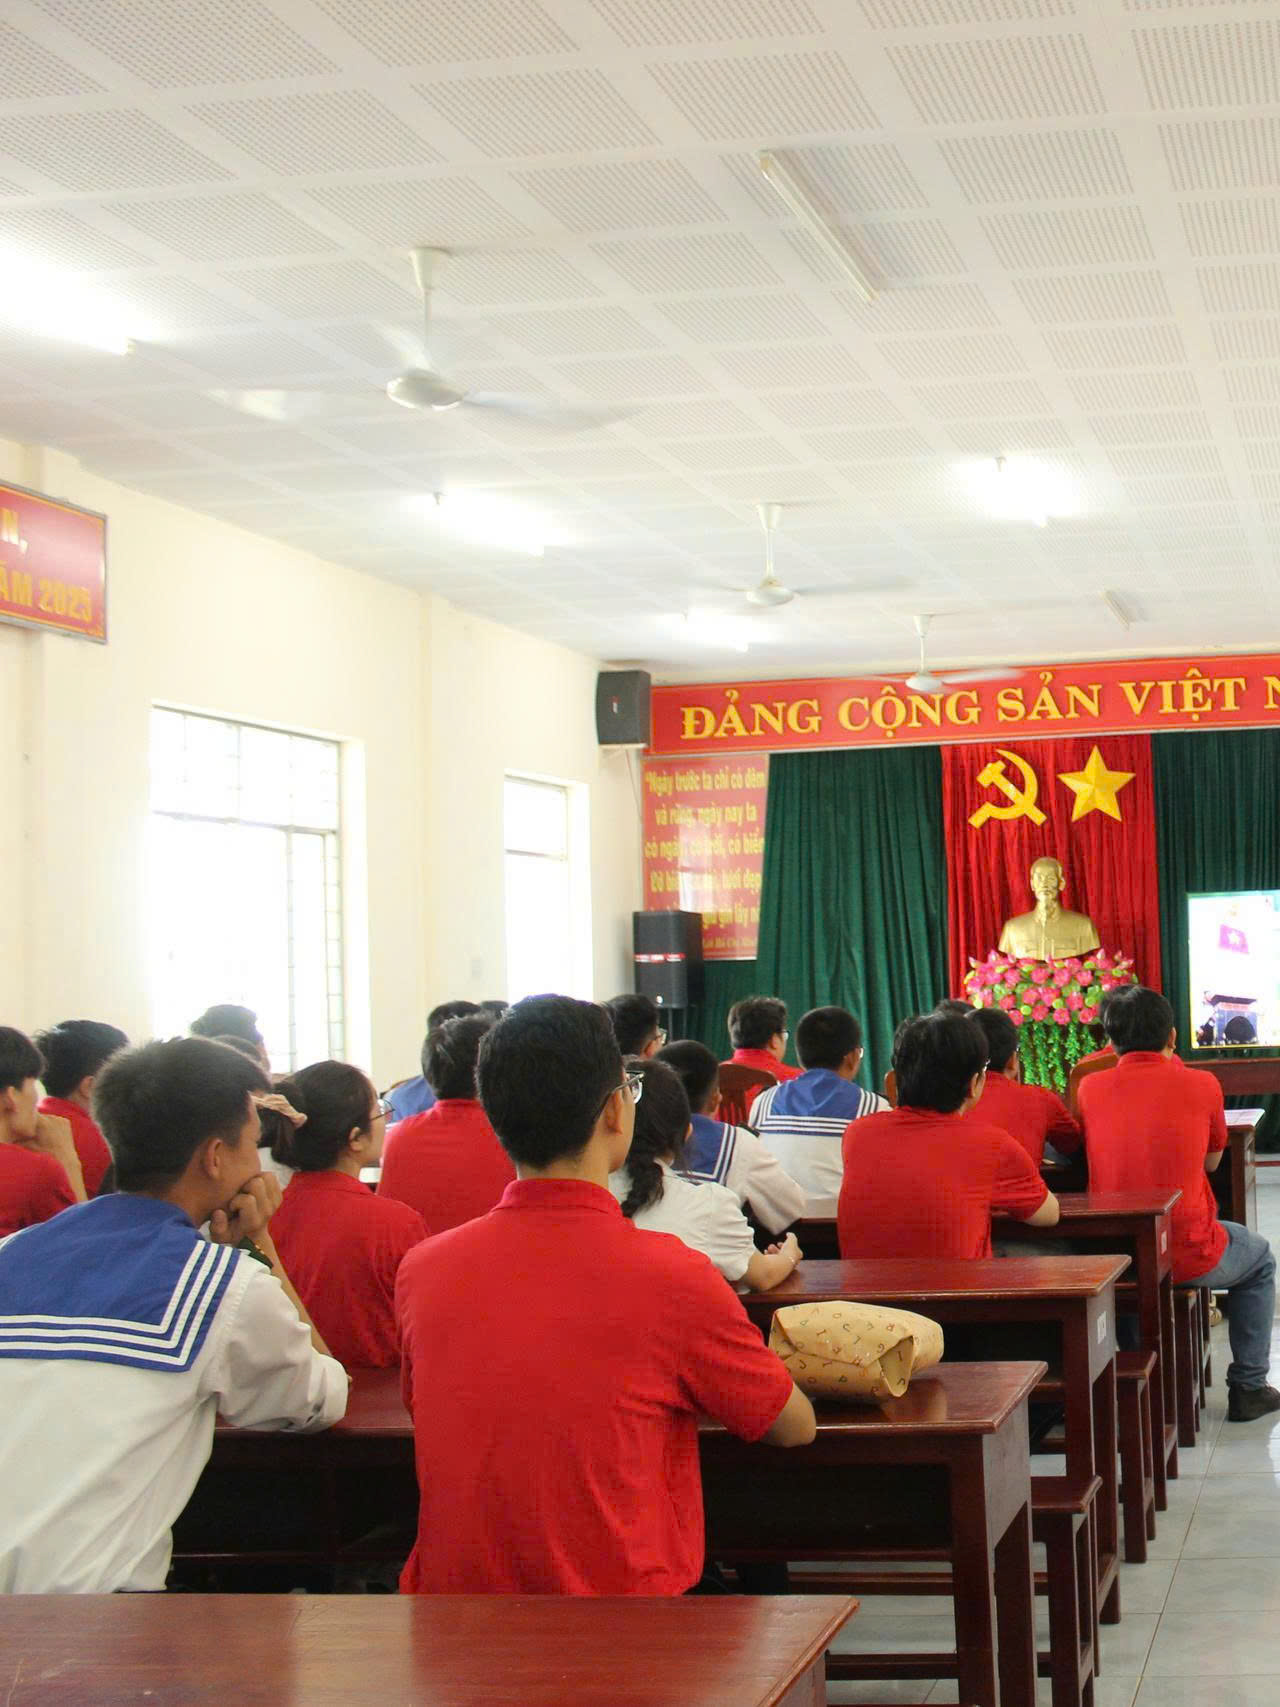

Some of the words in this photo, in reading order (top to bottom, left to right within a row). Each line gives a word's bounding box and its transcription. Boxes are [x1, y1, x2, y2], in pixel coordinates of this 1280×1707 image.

[680, 689, 822, 740] ĐẢNG
[838, 685, 982, 738] CỘNG
[996, 671, 1102, 722] SẢN
[1119, 667, 1246, 722] VIỆT
